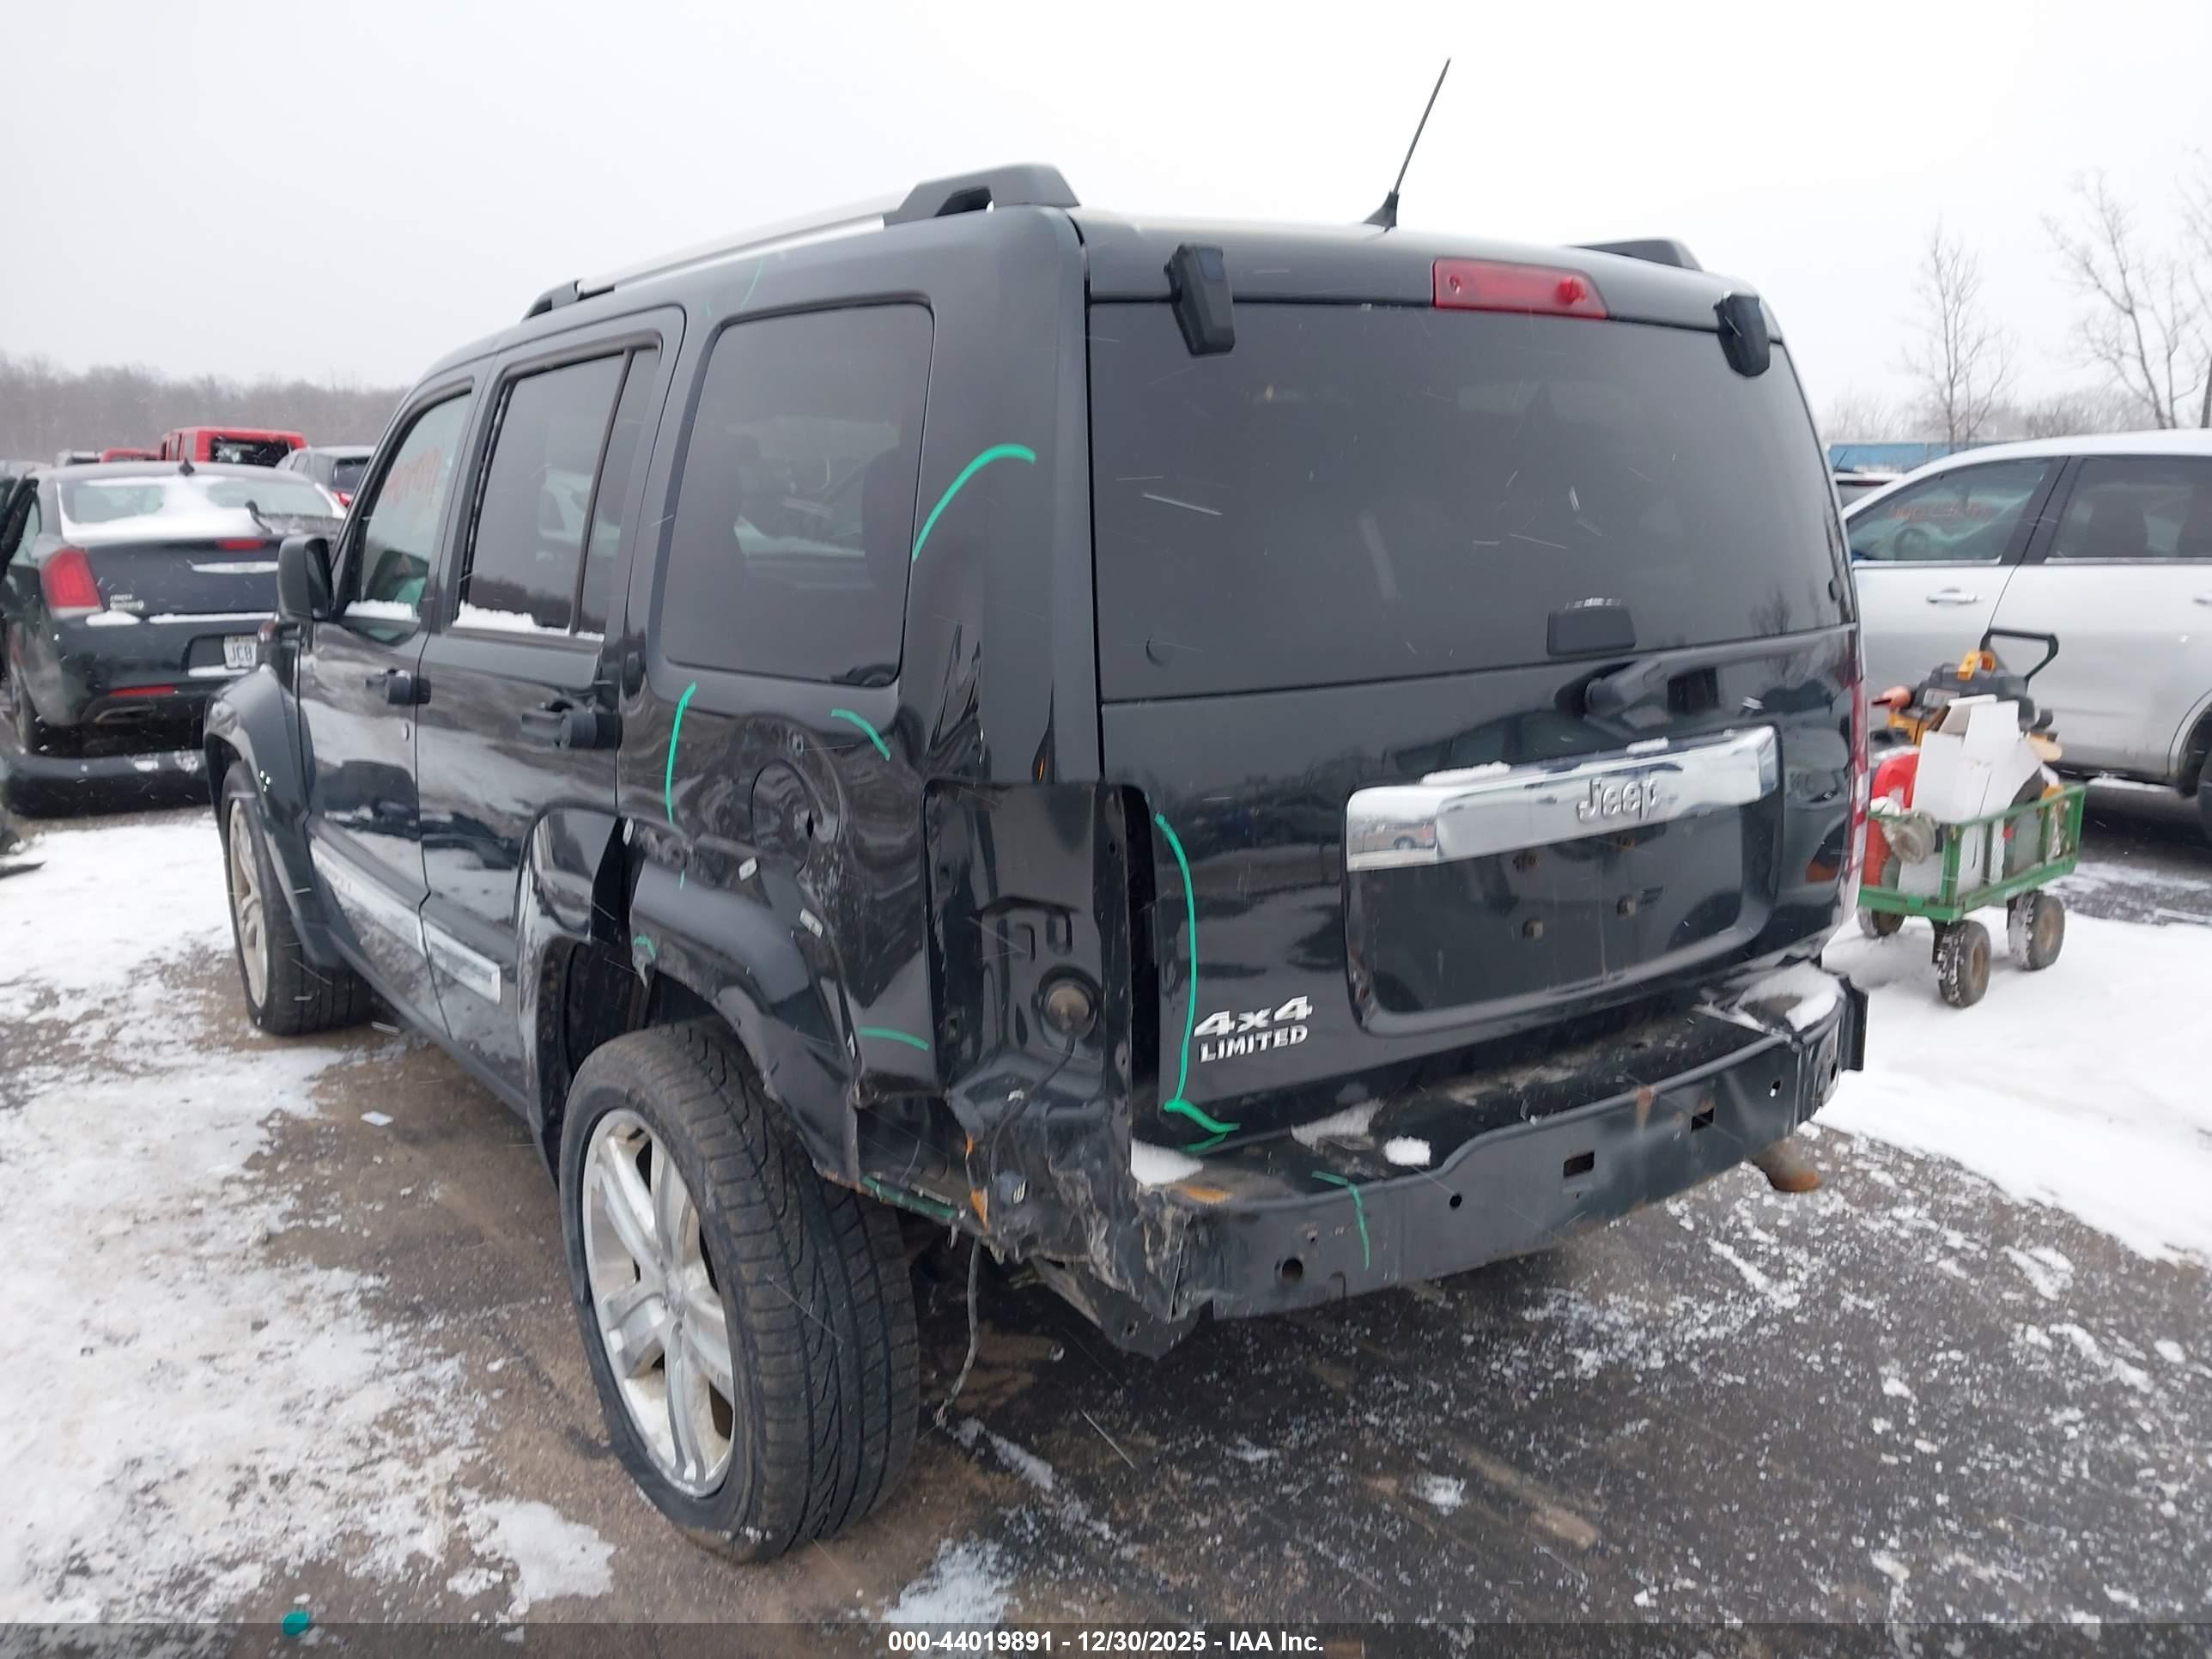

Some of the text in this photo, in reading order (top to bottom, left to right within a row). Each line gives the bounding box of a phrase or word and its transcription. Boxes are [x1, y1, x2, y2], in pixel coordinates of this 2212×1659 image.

[1577, 777, 1656, 822] Jeep
[1194, 995, 1313, 1037] 4x4
[1199, 1024, 1308, 1063] LIMITED
